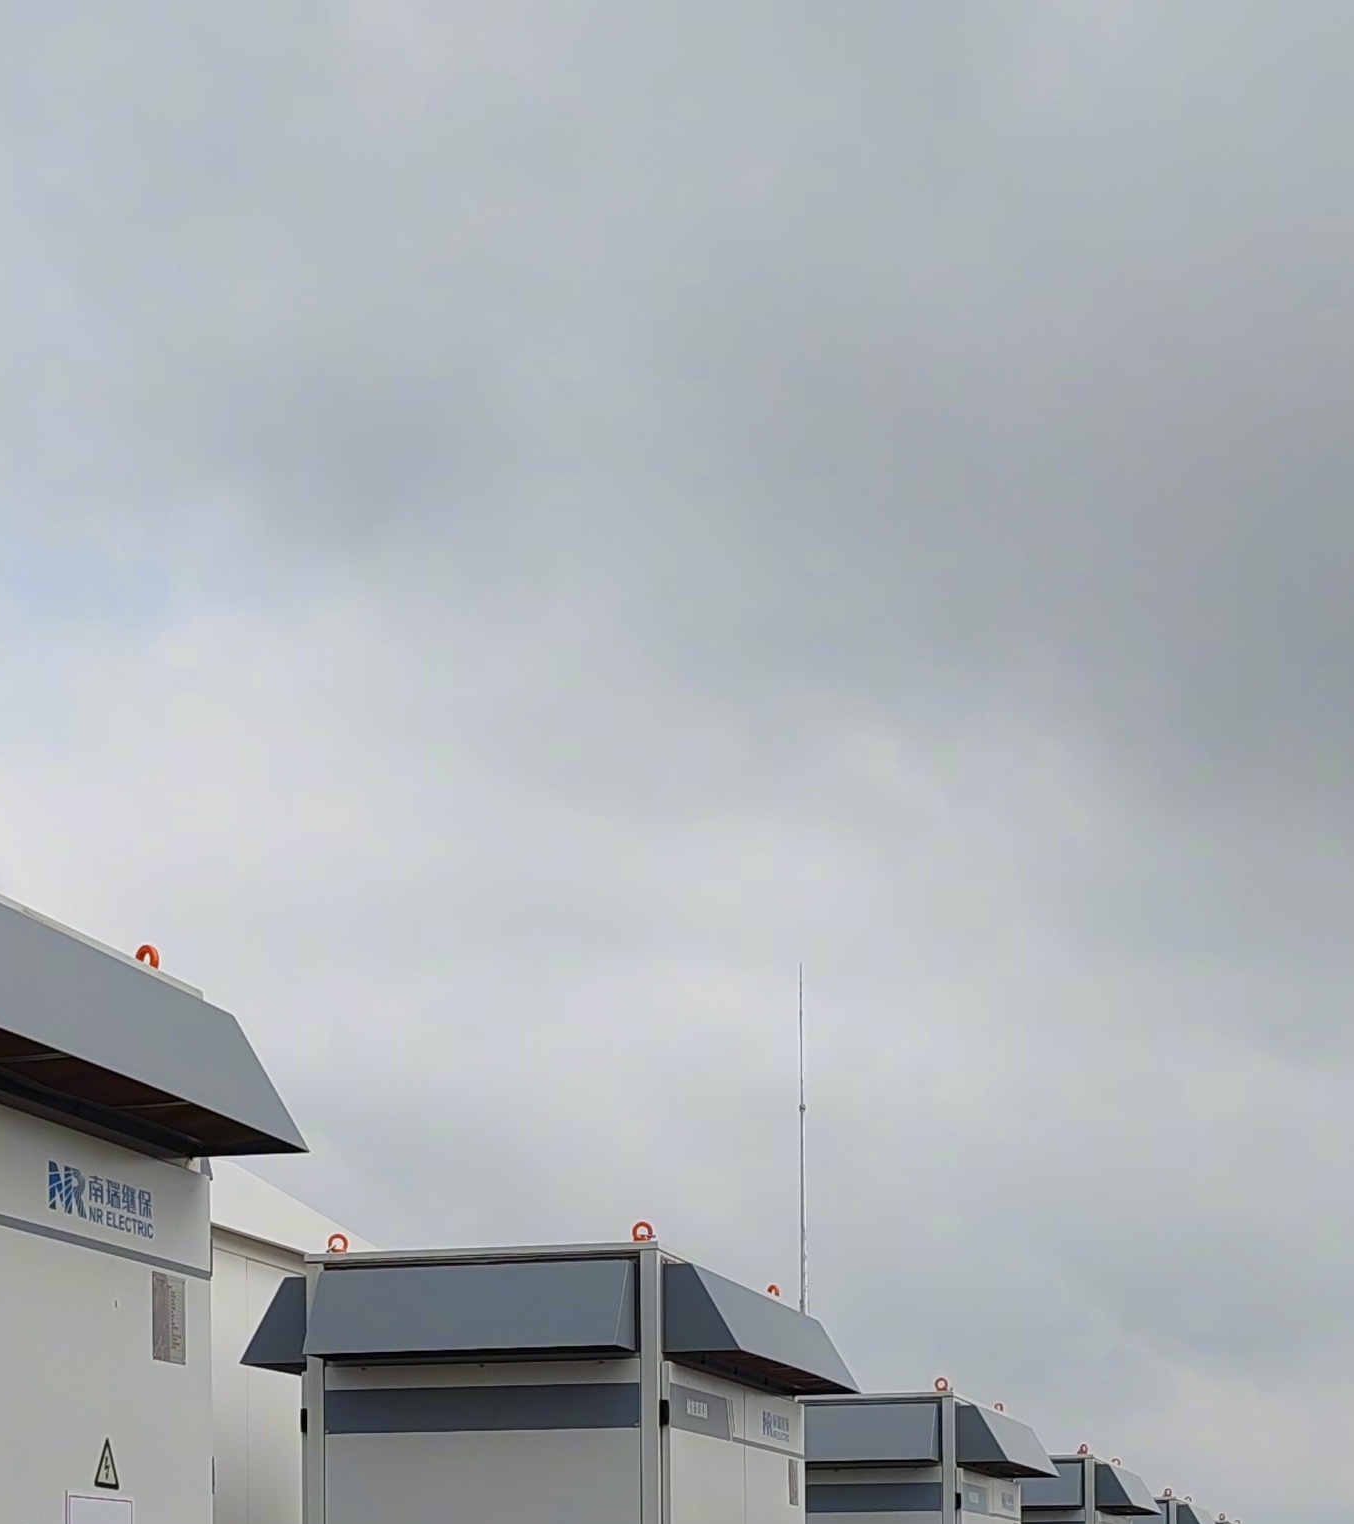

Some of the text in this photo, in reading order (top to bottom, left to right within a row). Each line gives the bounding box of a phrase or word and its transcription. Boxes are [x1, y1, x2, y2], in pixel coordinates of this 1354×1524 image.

[88, 1175, 153, 1219] 南瑞继保
[88, 1206, 154, 1239] NR ELECTRIC
